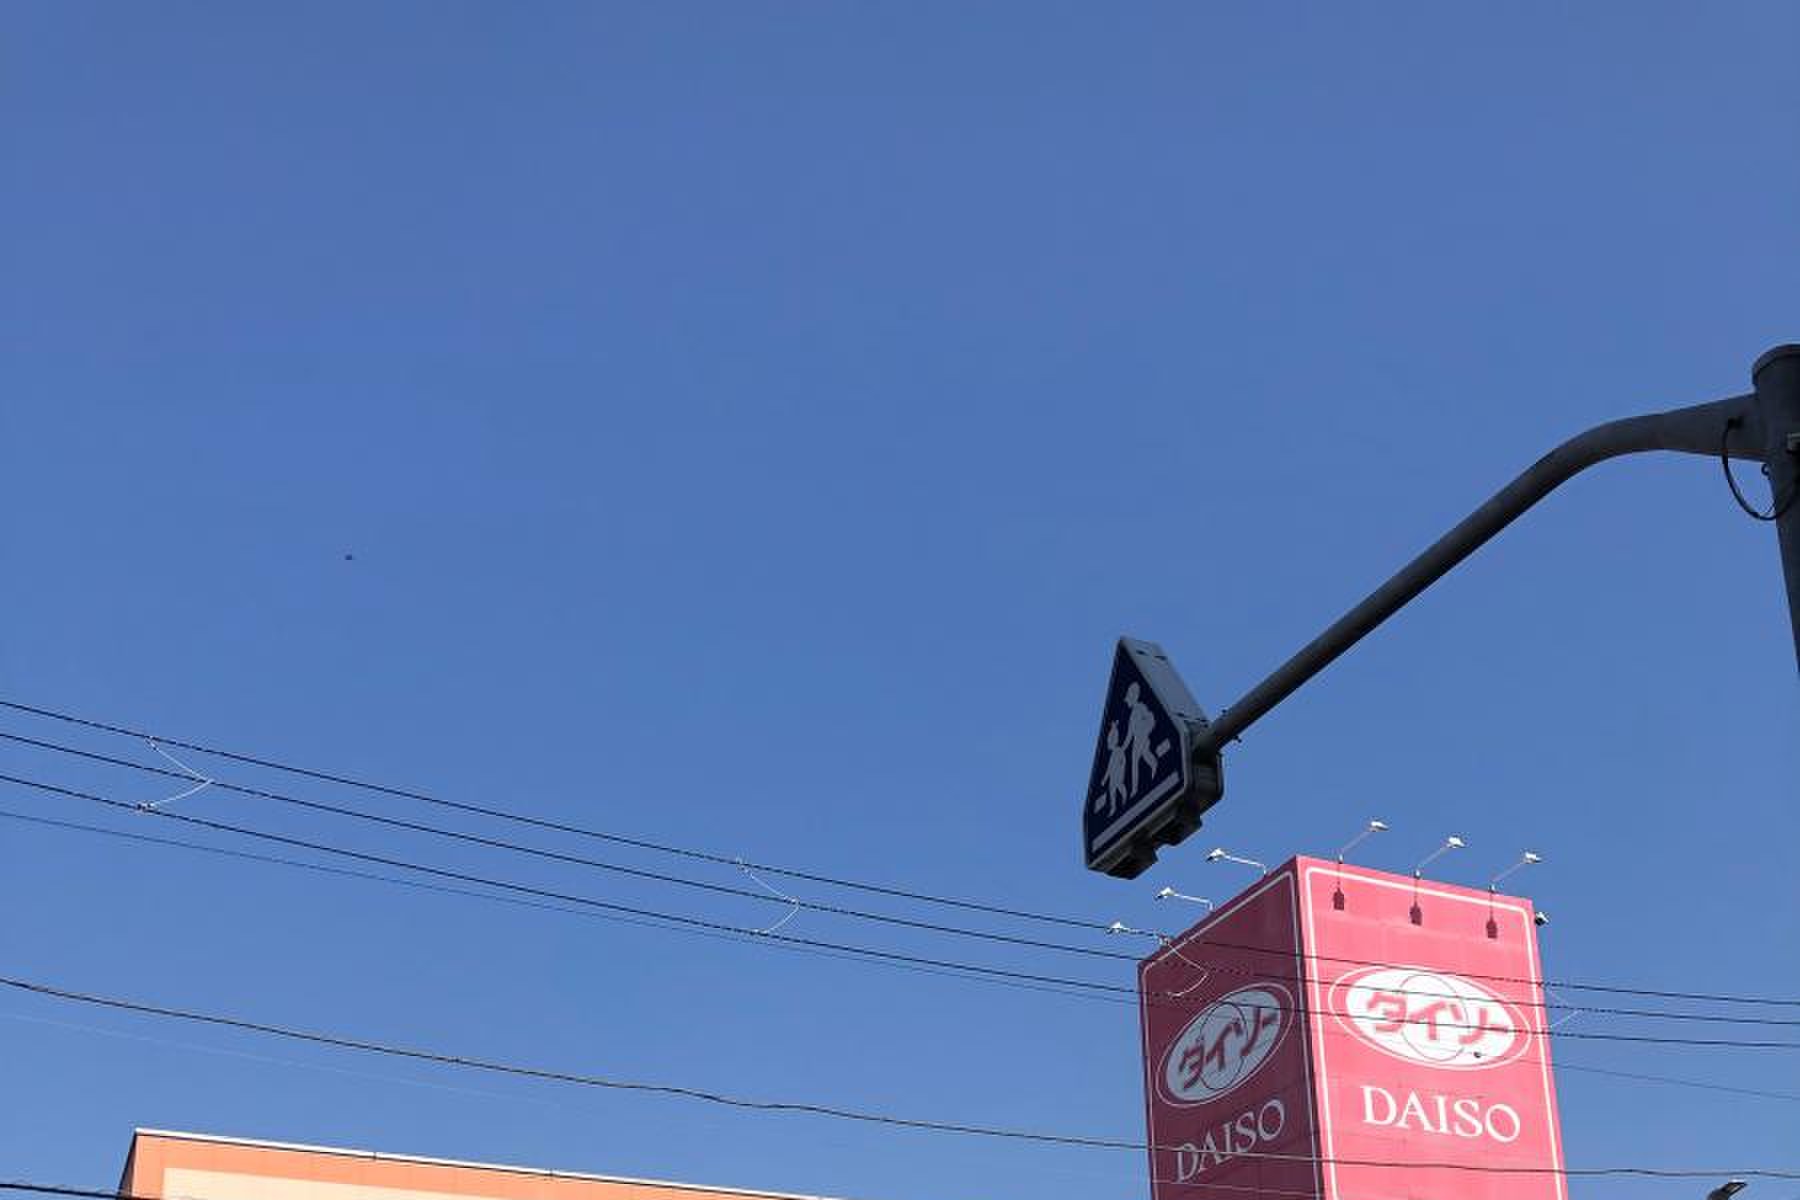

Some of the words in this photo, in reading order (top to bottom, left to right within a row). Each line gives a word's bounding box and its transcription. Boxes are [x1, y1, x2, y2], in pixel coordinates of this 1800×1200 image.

[1178, 1006, 1281, 1090] ダイソー
[1364, 989, 1510, 1045] ダイソー
[1176, 1099, 1286, 1184] DAISO
[1360, 1085, 1521, 1143] DAISO
